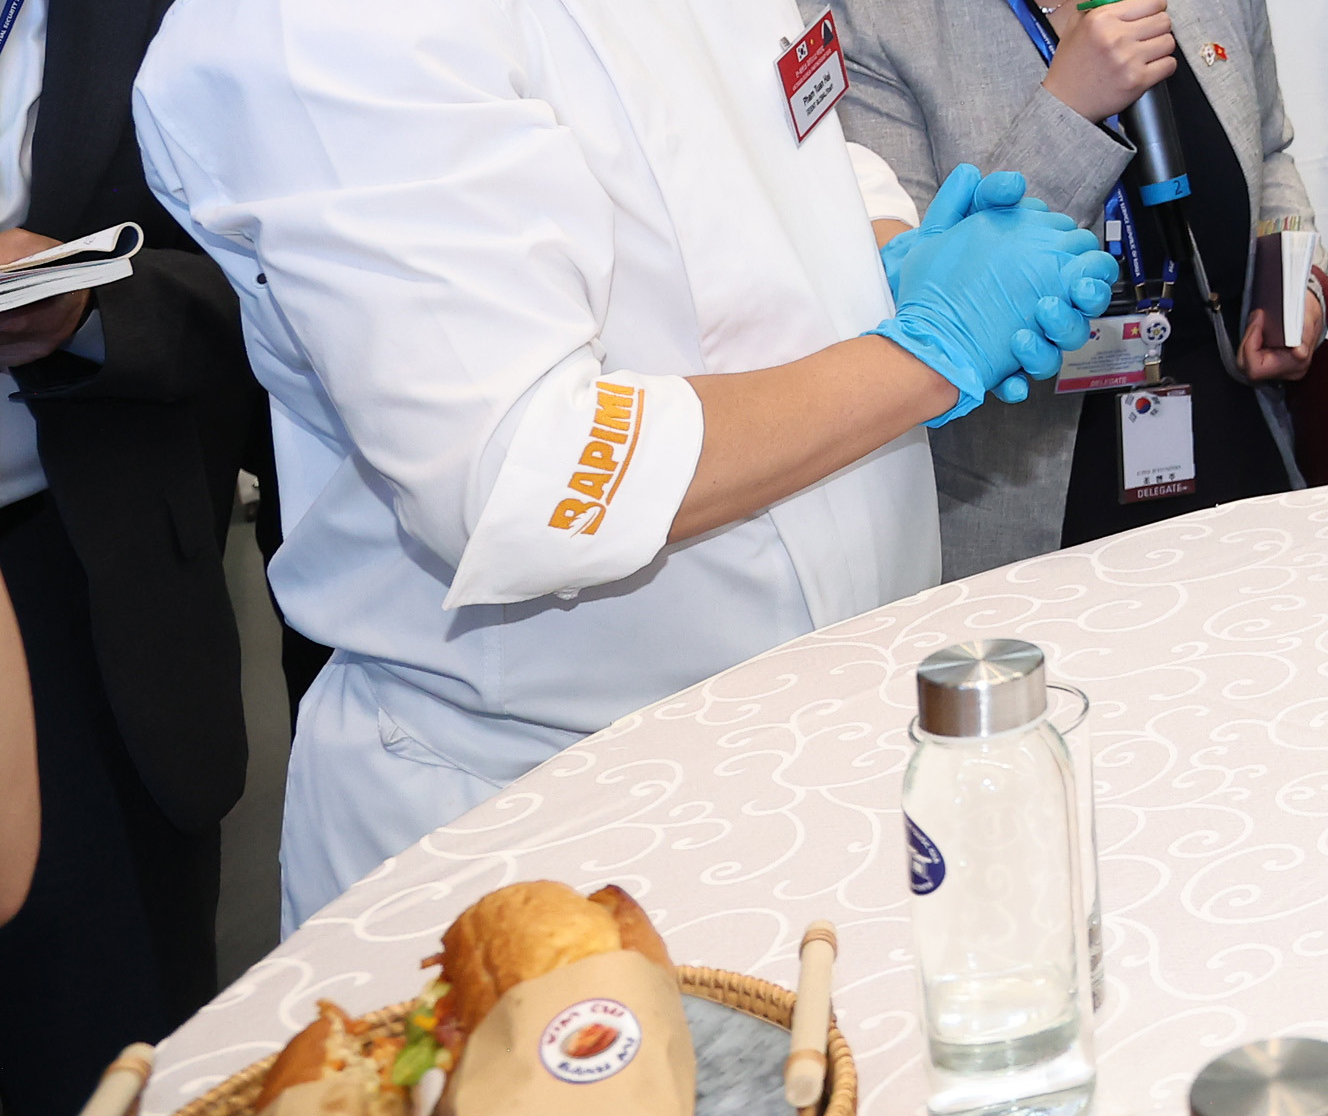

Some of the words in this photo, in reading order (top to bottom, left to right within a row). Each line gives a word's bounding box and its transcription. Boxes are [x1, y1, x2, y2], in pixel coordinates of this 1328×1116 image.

[1174, 180, 1183, 195] 2
[1089, 376, 1127, 388] DELEGATE
[548, 381, 637, 537] BAPIMI
[1137, 483, 1181, 499] DELEGATE
